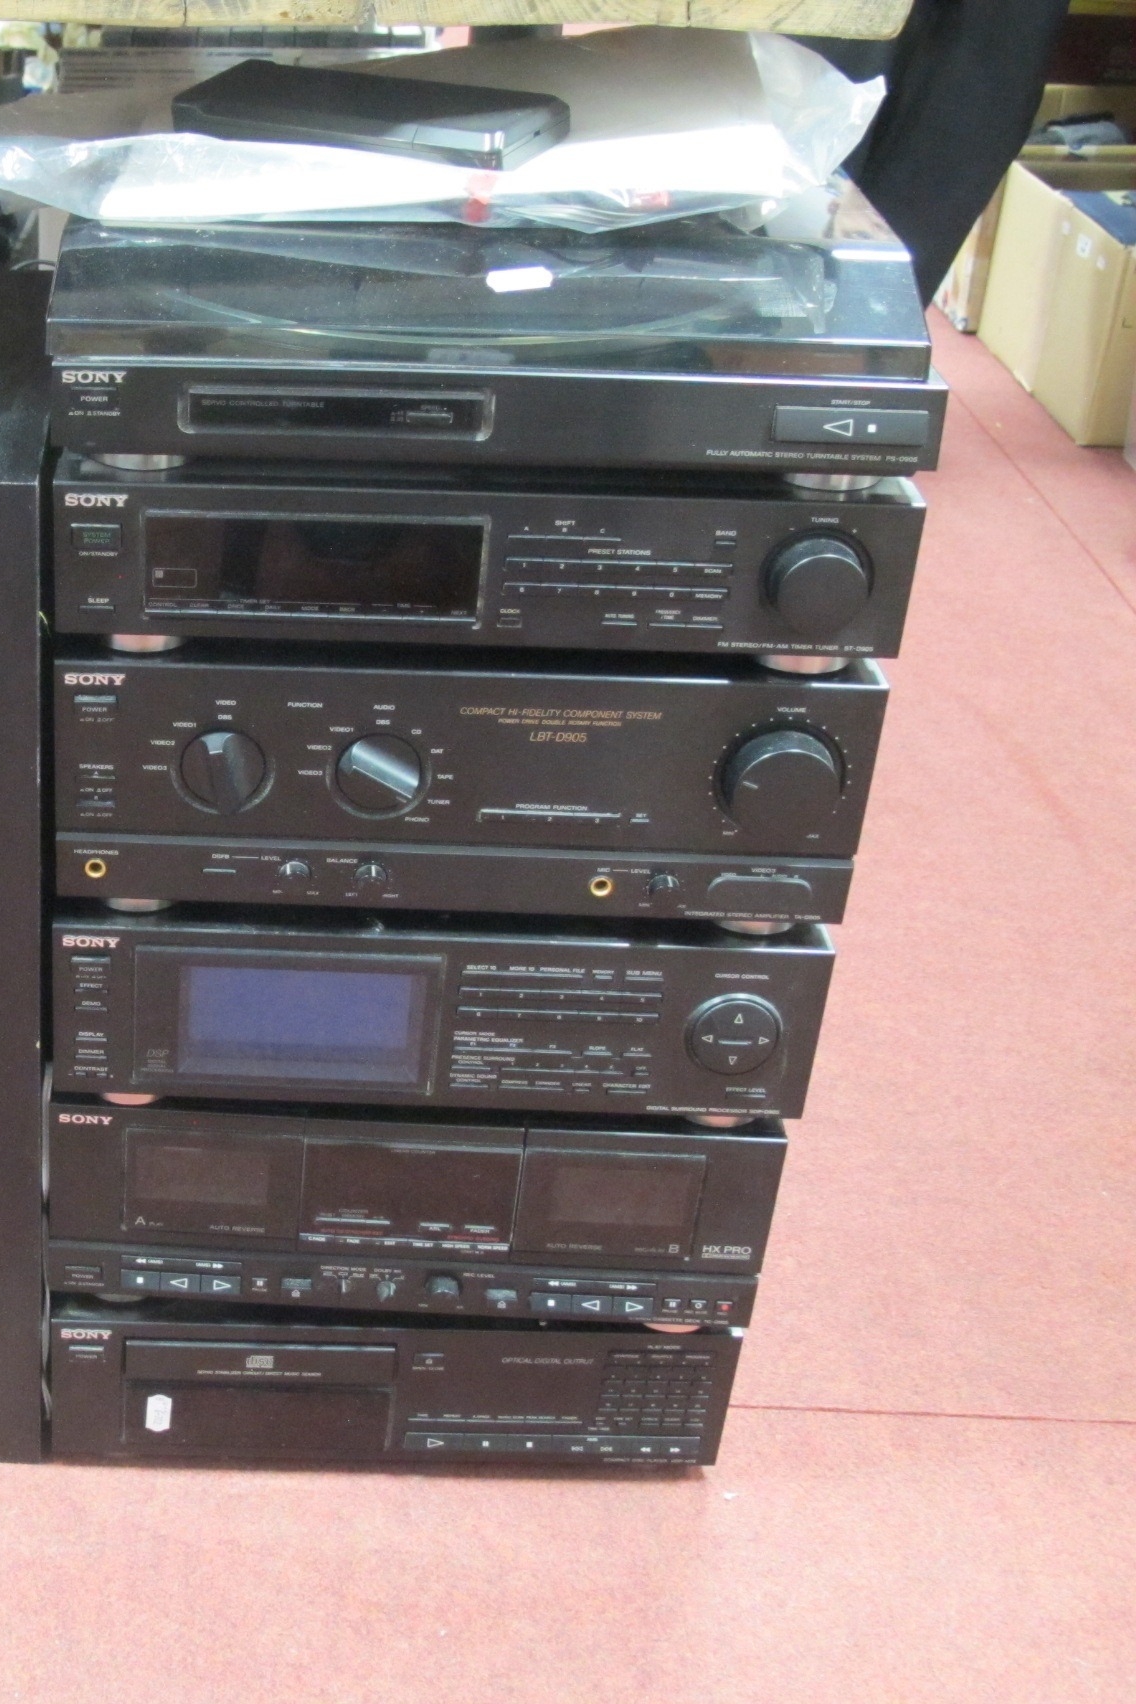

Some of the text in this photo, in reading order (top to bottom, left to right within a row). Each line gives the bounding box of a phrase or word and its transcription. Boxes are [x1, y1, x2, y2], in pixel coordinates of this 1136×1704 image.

[61, 369, 127, 384] SONY
[79, 395, 109, 403] POWER
[705, 449, 729, 457] FULLY
[728, 450, 773, 459] AUTOMATIC
[774, 451, 804, 460] STEREO
[805, 452, 849, 461] TURNTABLE
[850, 453, 882, 462] SYSTEM
[64, 492, 130, 508] SONY
[554, 519, 576, 527] SHIFT
[810, 516, 840, 524] TUNING
[715, 529, 737, 537] BAND
[78, 550, 119, 558] ON/STANDBY
[616, 548, 652, 556] STATIONS
[87, 596, 110, 604] SLEEP
[717, 640, 729, 648] FM
[814, 644, 839, 652] TUNER
[63, 672, 127, 687] SONY
[215, 699, 237, 707] VIDEO
[287, 701, 324, 709] FUNCTION
[372, 704, 396, 712] AUDIO
[776, 706, 807, 714] VOLUME
[459, 706, 664, 721] COMPACT HI-FIDELITY COMPONENT SYSTEM
[528, 731, 588, 744] LBT-D905
[78, 763, 115, 771] SPEAKERS
[436, 773, 454, 781] TAPE
[515, 803, 589, 812] PROGRAM FUNCTION
[73, 848, 120, 856] HEADPHONES
[325, 857, 359, 865] BALANCE
[61, 934, 121, 949] SONY
[714, 972, 771, 981] CURSOR CONTROL
[146, 1049, 170, 1058] DSP
[58, 1112, 114, 1126] SONY
[134, 1215, 146, 1226] A
[208, 1224, 230, 1232] AUTO
[545, 1242, 603, 1252] AUTO REVERSE
[667, 1243, 681, 1254] B
[701, 1244, 753, 1256] HX PRO
[60, 1328, 113, 1340] SONY
[501, 1356, 534, 1365] OPTICAL
[533, 1357, 562, 1365] DIGITAL
